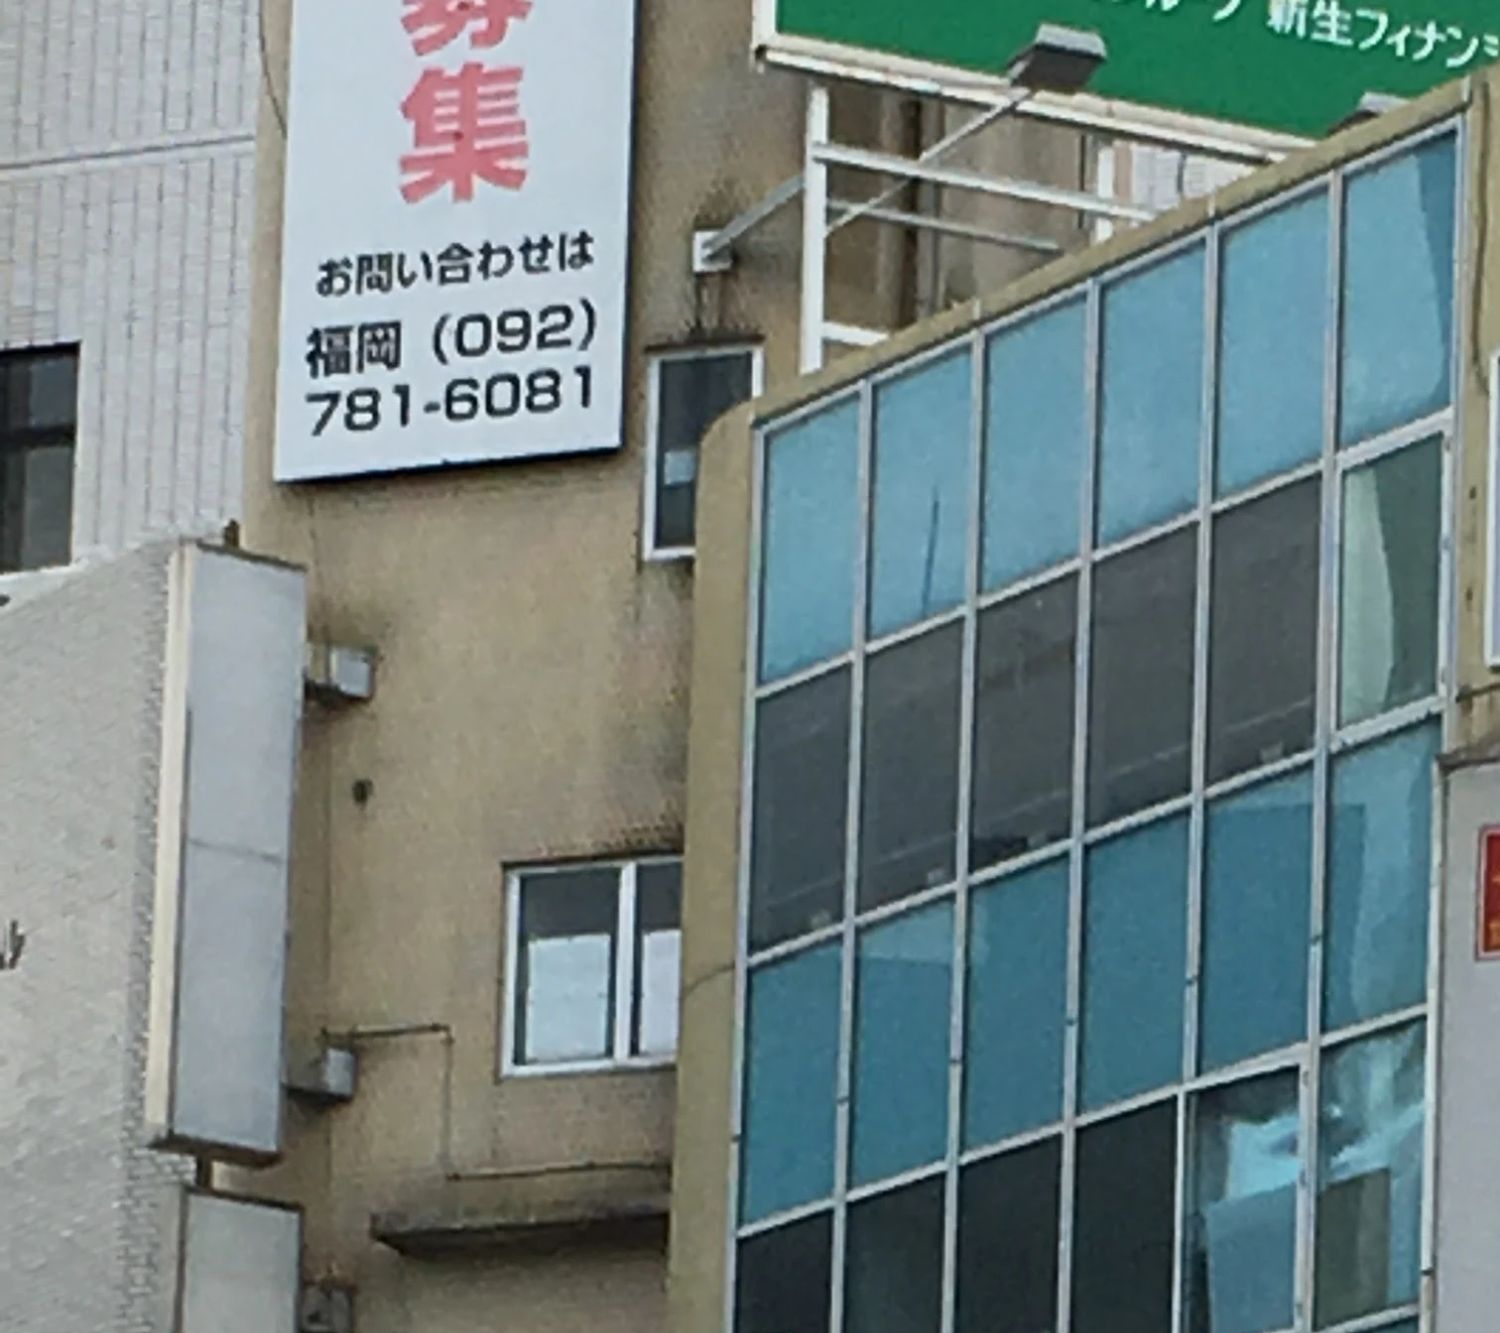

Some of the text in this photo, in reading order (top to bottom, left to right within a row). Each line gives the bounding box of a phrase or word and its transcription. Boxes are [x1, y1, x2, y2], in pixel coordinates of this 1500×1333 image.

[316, 229, 594, 297] お問い合わせは
[304, 296, 597, 380] 福岡 (092)
[304, 364, 592, 437] 781-6081
